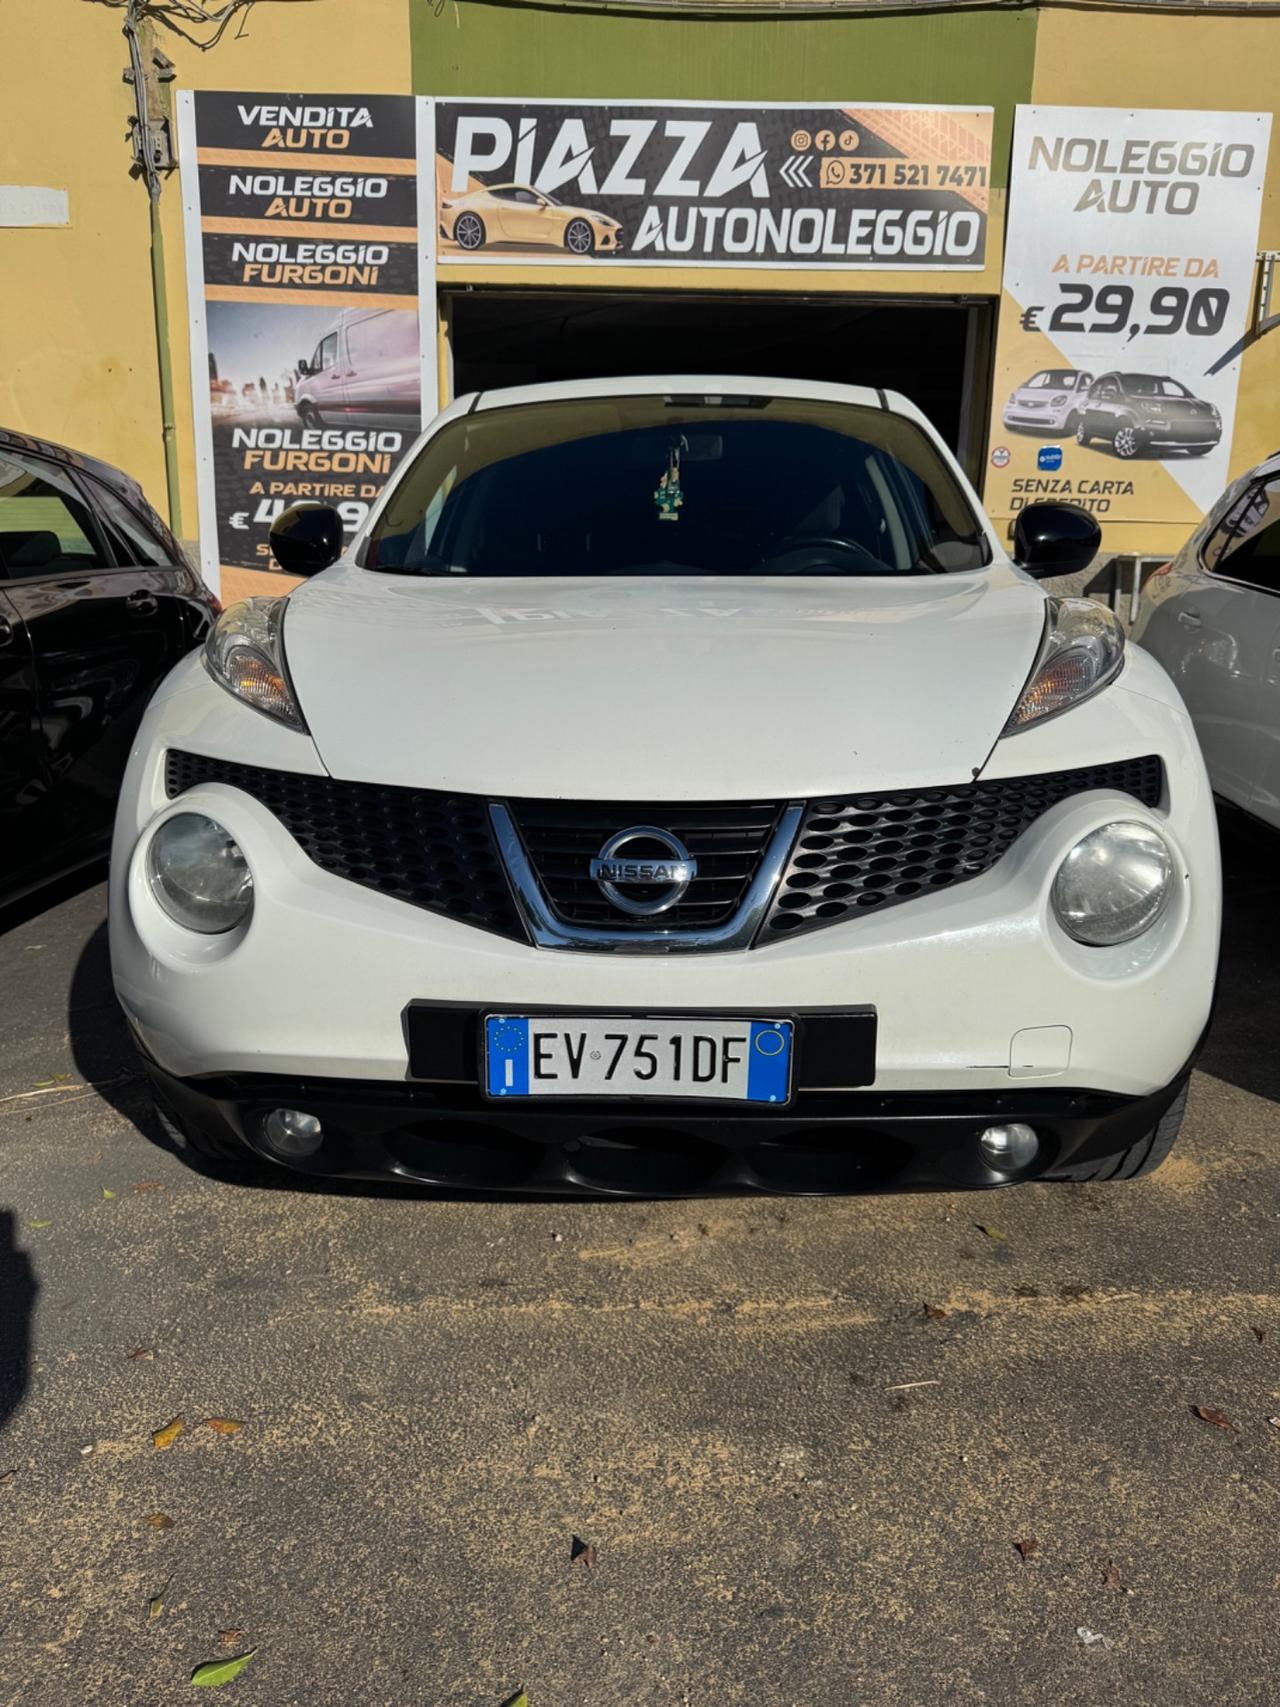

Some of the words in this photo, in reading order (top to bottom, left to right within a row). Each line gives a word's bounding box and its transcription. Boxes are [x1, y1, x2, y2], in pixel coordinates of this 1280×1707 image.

[237, 105, 374, 128] VENDITA
[261, 128, 350, 149] AUTO
[451, 116, 770, 198] PIAZZA
[1028, 136, 1255, 178] NOLEGGIO
[228, 174, 389, 198] NOLEGGIO
[850, 163, 886, 185] 371
[894, 164, 929, 186] 521
[937, 165, 987, 187] 7471
[264, 198, 352, 218] AUTO
[1073, 179, 1200, 215] AUTO
[631, 206, 980, 256] AUTONOLEGGIO
[231, 243, 389, 265] NOLEGGIO
[1051, 254, 1070, 273] A
[1076, 255, 1180, 277] PARTIRE
[1184, 258, 1220, 278] DA
[242, 264, 379, 286] FURGONI
[231, 428, 402, 452] NOLEGGIO
[243, 450, 392, 474] FURGONI
[249, 481, 265, 495] A
[270, 482, 356, 497] PARTIRE
[1011, 479, 1072, 493] SENZA
[1077, 480, 1134, 495] CARTA
